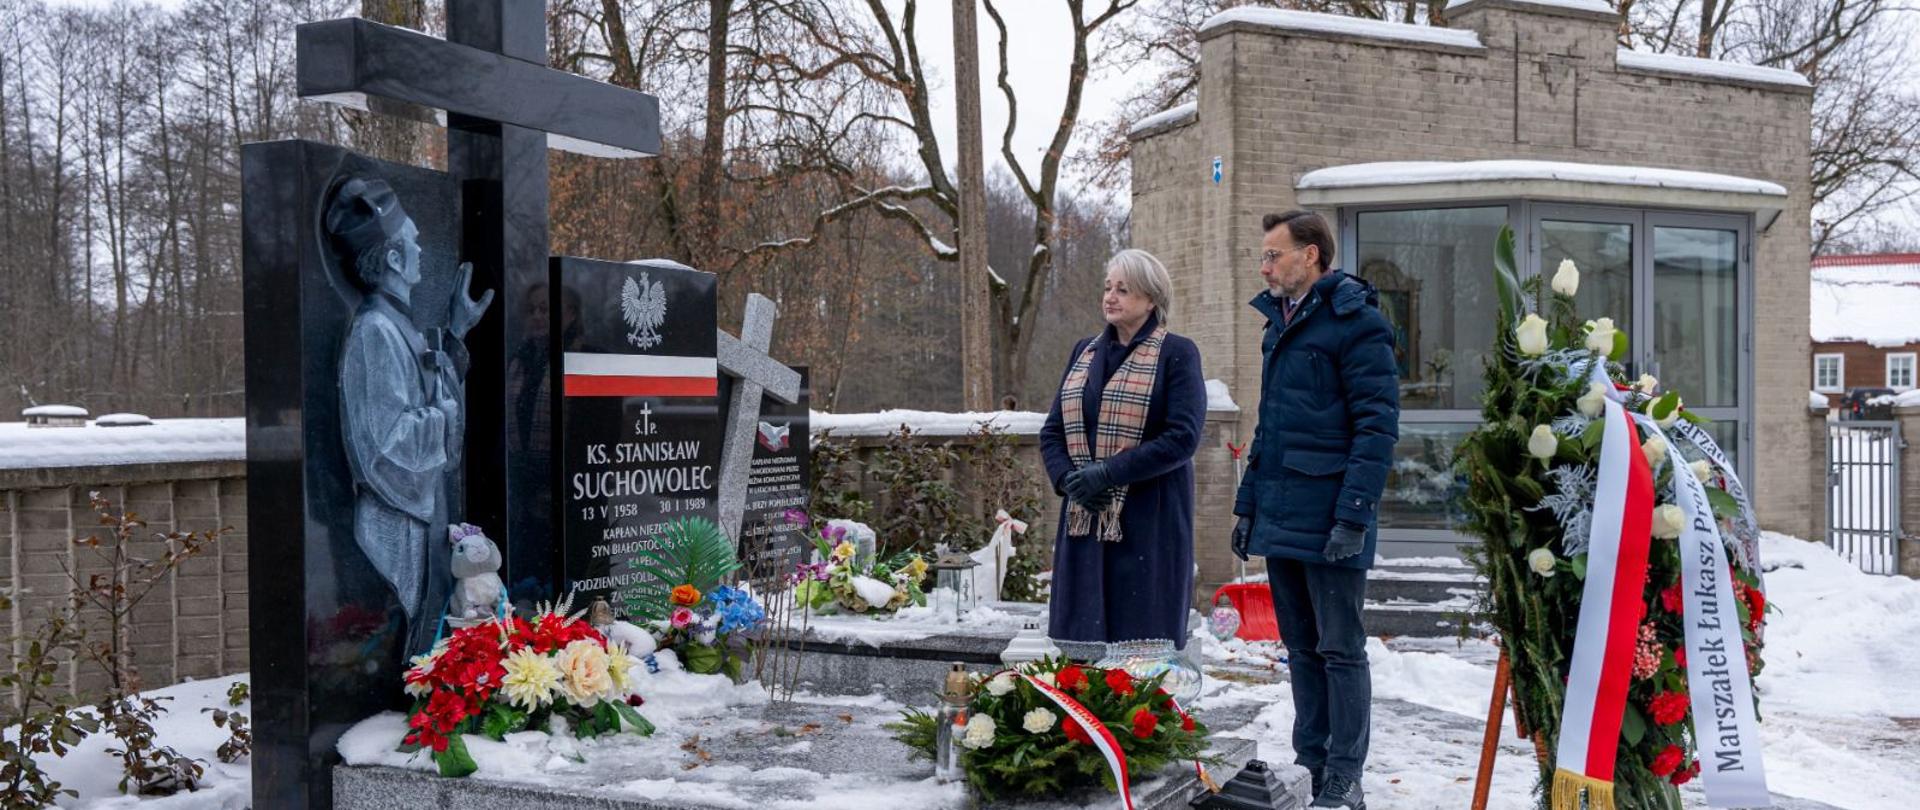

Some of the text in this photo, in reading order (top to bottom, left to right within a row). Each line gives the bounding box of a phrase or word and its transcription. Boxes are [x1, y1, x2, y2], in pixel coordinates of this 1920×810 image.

[587, 440, 700, 465] KS. STANISŁAW
[573, 465, 712, 500] SUCHOWOLEC
[582, 506, 595, 520] 13
[600, 505, 608, 519] V
[614, 503, 638, 518] 1958
[660, 500, 671, 514] 30
[685, 497, 706, 511] 1989
[603, 525, 638, 540] KAPŁAN
[591, 545, 610, 558] SYN
[1694, 541, 1721, 631] Łukasz
[1698, 637, 1745, 773] Marszałek
